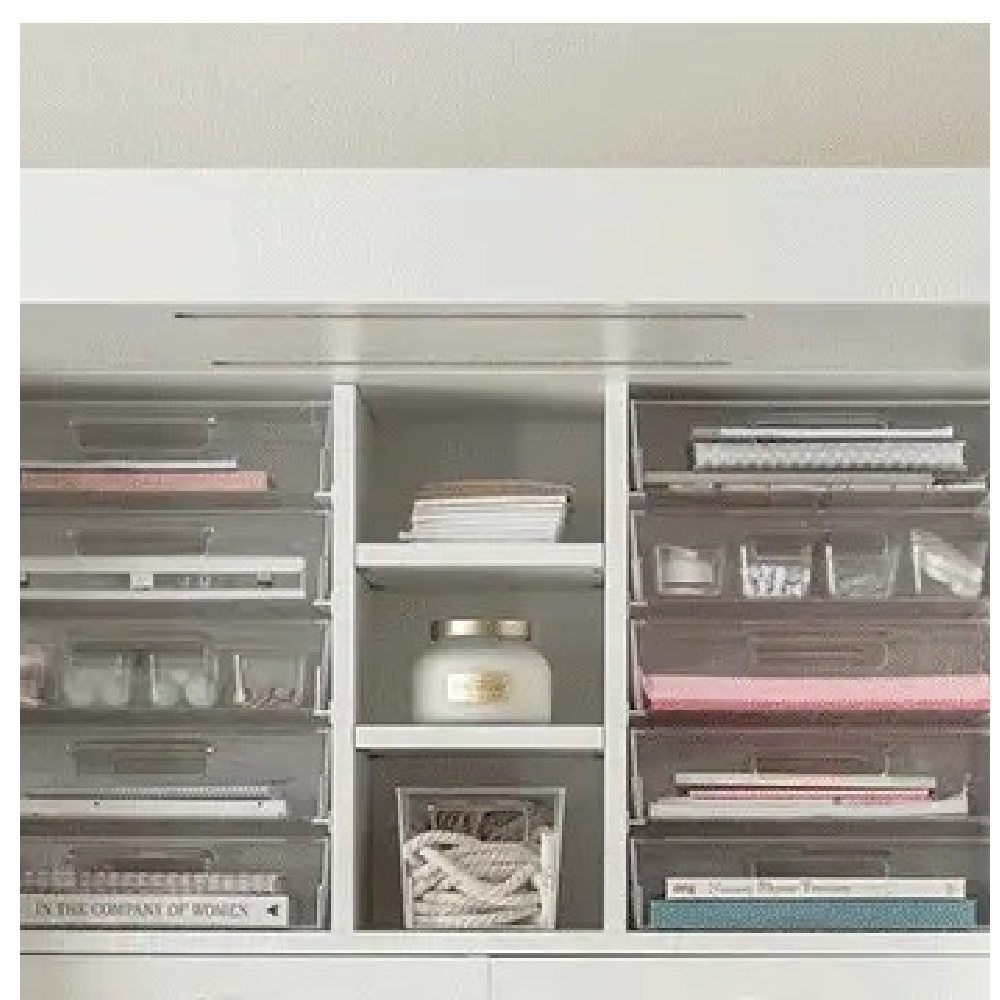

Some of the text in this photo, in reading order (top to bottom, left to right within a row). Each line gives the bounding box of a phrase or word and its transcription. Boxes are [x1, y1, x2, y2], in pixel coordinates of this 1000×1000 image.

[34, 902, 249, 916] IN THE COMPANY OF WOMEN
